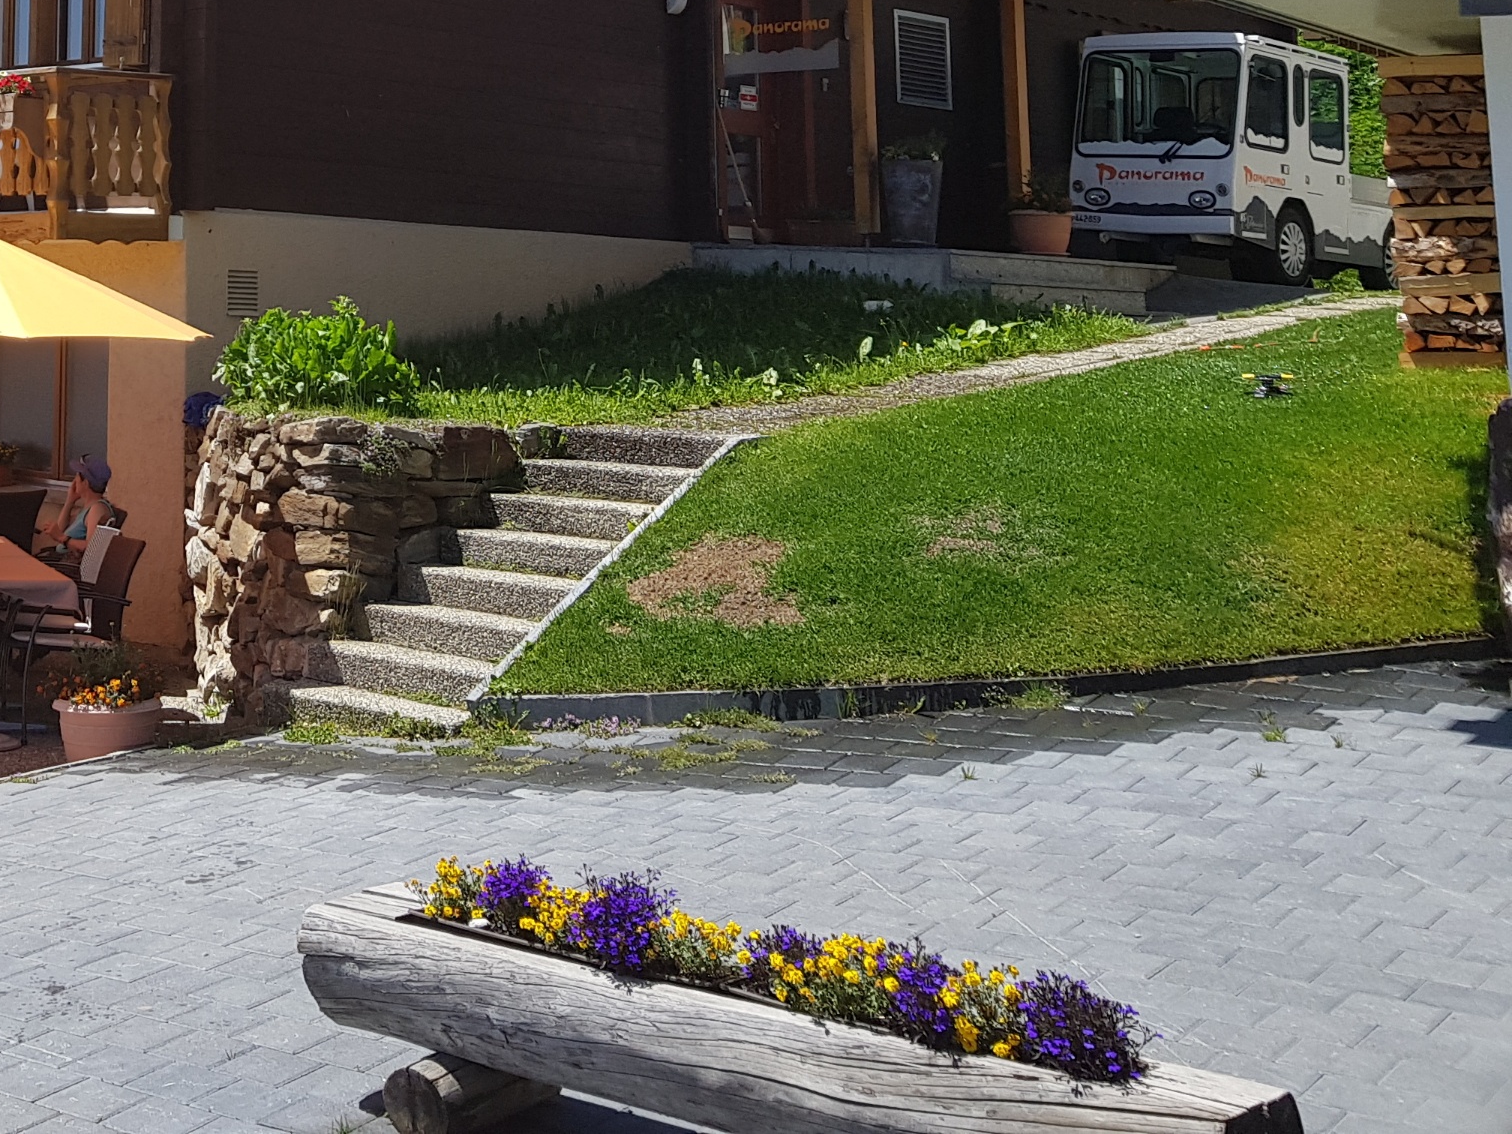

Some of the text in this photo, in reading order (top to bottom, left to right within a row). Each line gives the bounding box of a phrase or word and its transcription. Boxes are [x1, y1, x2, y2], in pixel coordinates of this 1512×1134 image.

[731, 16, 830, 40] Panorama
[1096, 163, 1204, 185] Panorama
[1243, 165, 1286, 186] Panorama
